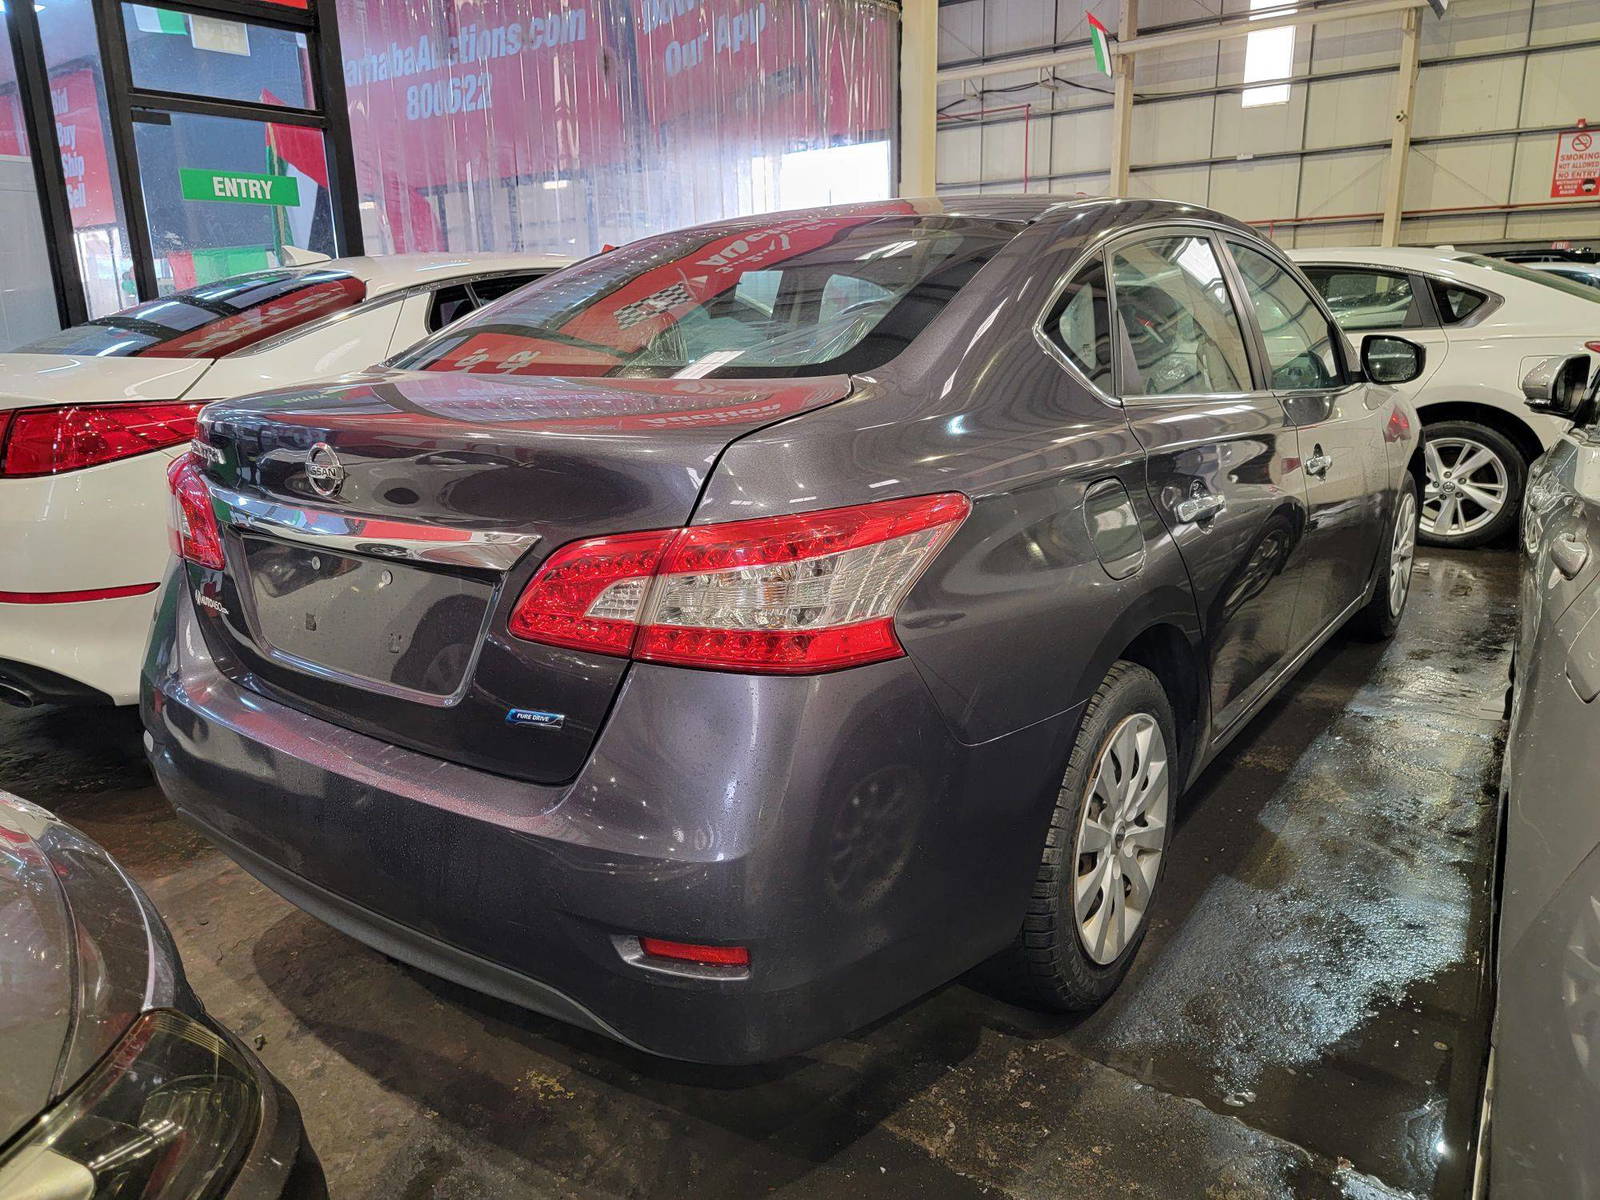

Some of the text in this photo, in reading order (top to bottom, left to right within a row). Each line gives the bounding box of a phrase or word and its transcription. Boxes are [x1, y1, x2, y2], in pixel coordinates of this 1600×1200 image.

[345, 8, 587, 88] arhabaAuctions.com
[665, 2, 767, 78] Our App
[406, 72, 494, 121] 800622
[56, 122, 77, 151] Buy
[1560, 152, 1600, 161] SMOKING
[1572, 161, 1600, 169] ALLOWED
[1572, 170, 1597, 178] ENTRY
[212, 176, 273, 200] ENTRY
